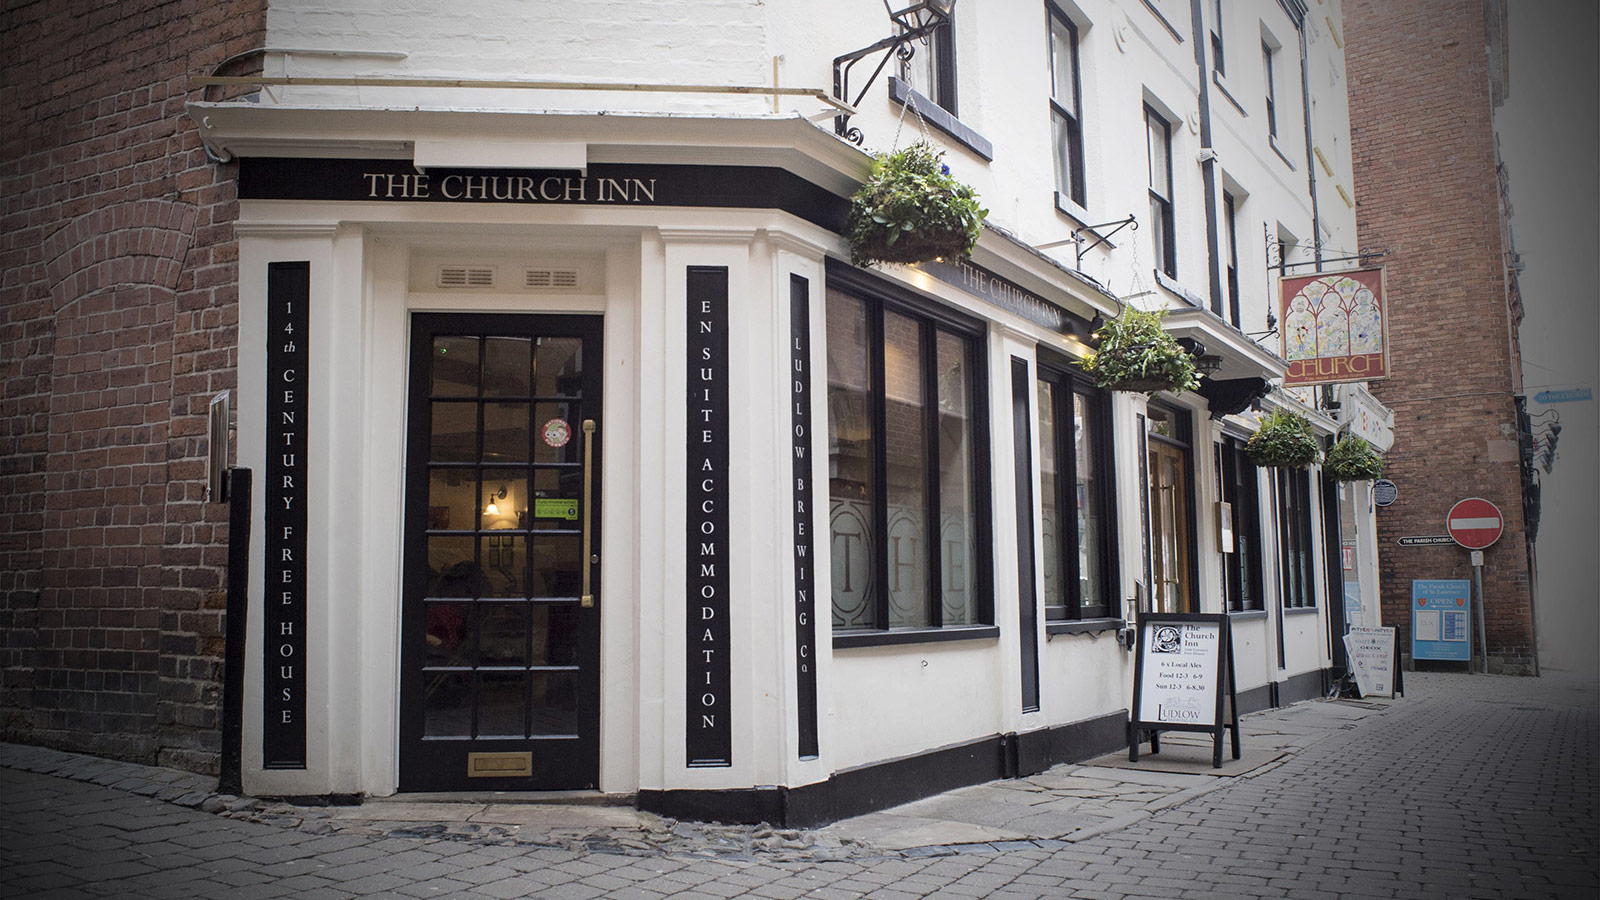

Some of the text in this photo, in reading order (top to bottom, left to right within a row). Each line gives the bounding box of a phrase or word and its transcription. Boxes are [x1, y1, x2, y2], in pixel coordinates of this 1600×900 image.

[363, 173, 656, 202] THE CHURCH INN
[961, 262, 1061, 327] THE CHURCH INN
[1287, 354, 1383, 378] CHURCH
[795, 338, 805, 459] LUDLOW
[281, 301, 296, 723] 14th CENTURY FREE HOUSE
[700, 301, 715, 727] EN SUITE ACCOMMODATION
[796, 478, 808, 626] BREWING
[1185, 624, 1200, 632] The
[1185, 632, 1215, 640] Church
[1158, 704, 1201, 721] LUDLOW
